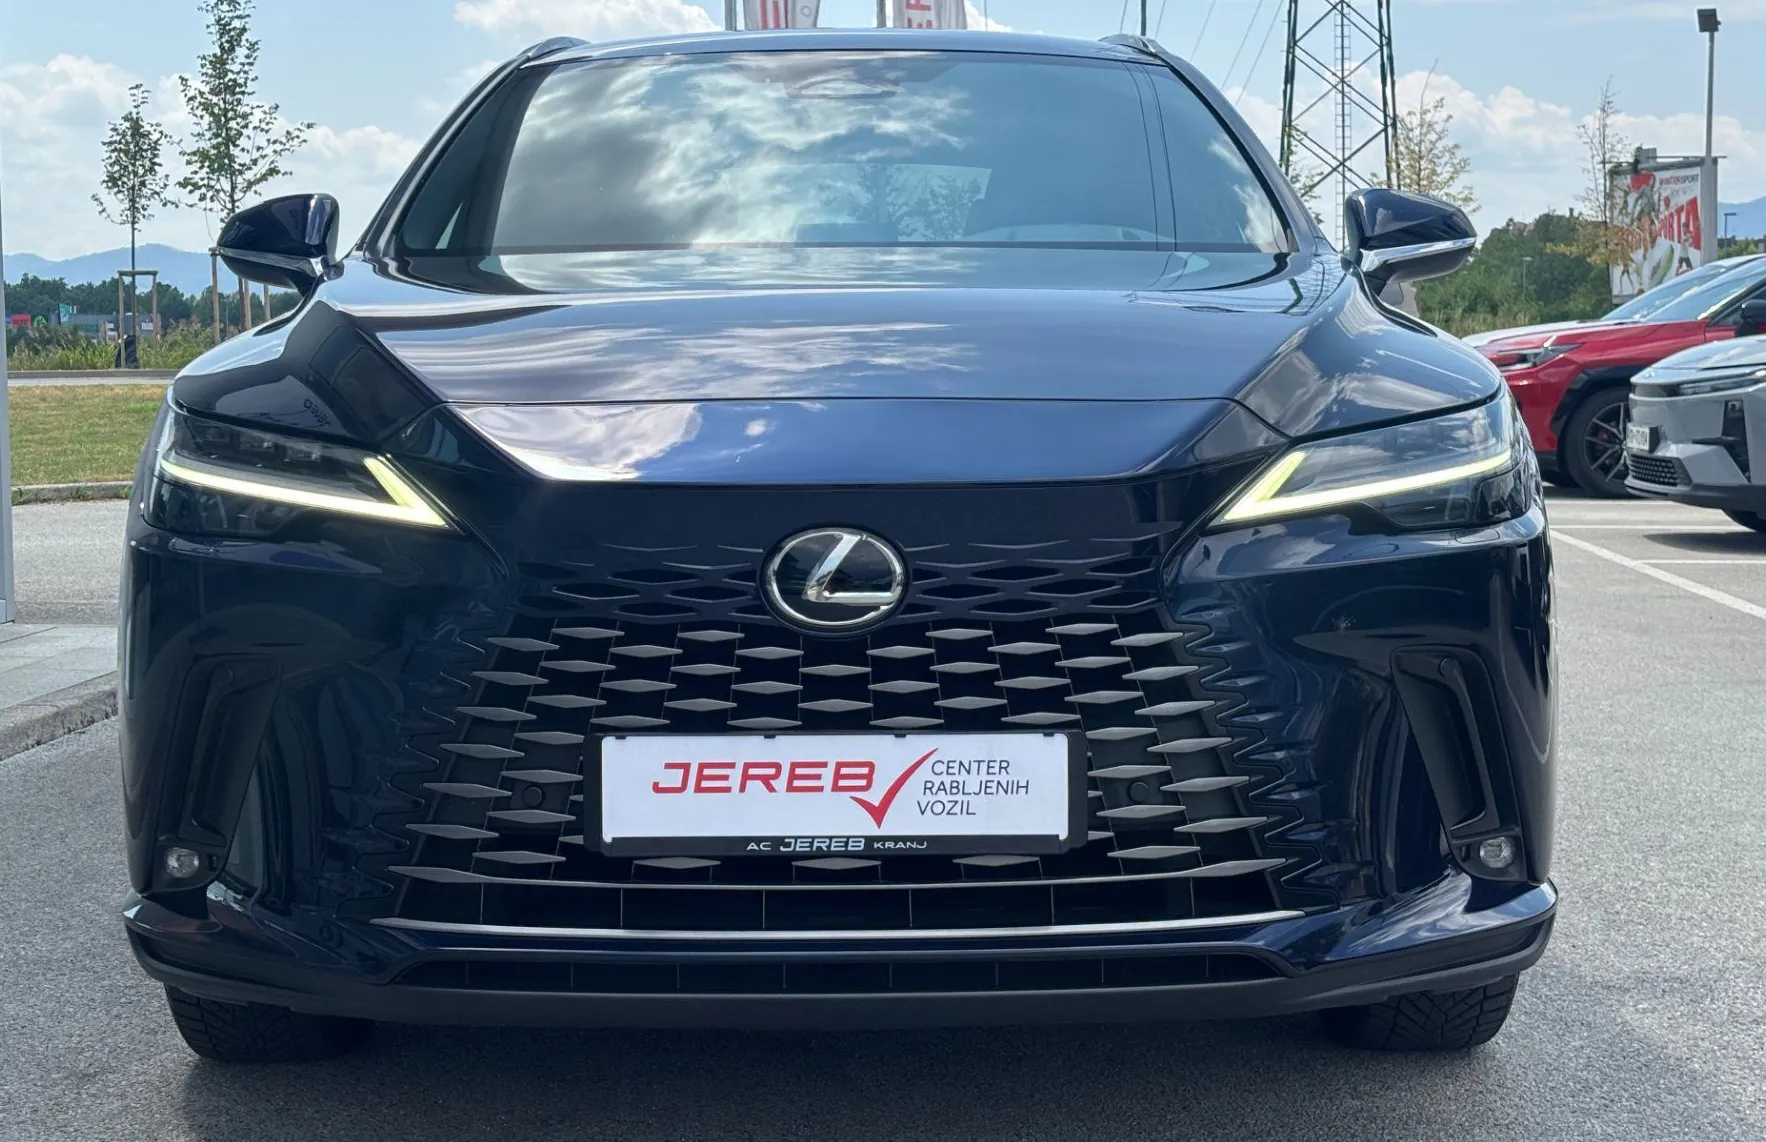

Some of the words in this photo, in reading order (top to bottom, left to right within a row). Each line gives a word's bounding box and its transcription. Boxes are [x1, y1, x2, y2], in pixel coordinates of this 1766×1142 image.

[931, 759, 1010, 776] CENTER
[651, 760, 876, 794] JEREB
[922, 779, 1030, 796] RABLJENIH
[916, 799, 977, 816] VOZIL
[746, 841, 772, 851] AC
[779, 837, 866, 852] JEREB
[873, 841, 928, 850] KRANJ
